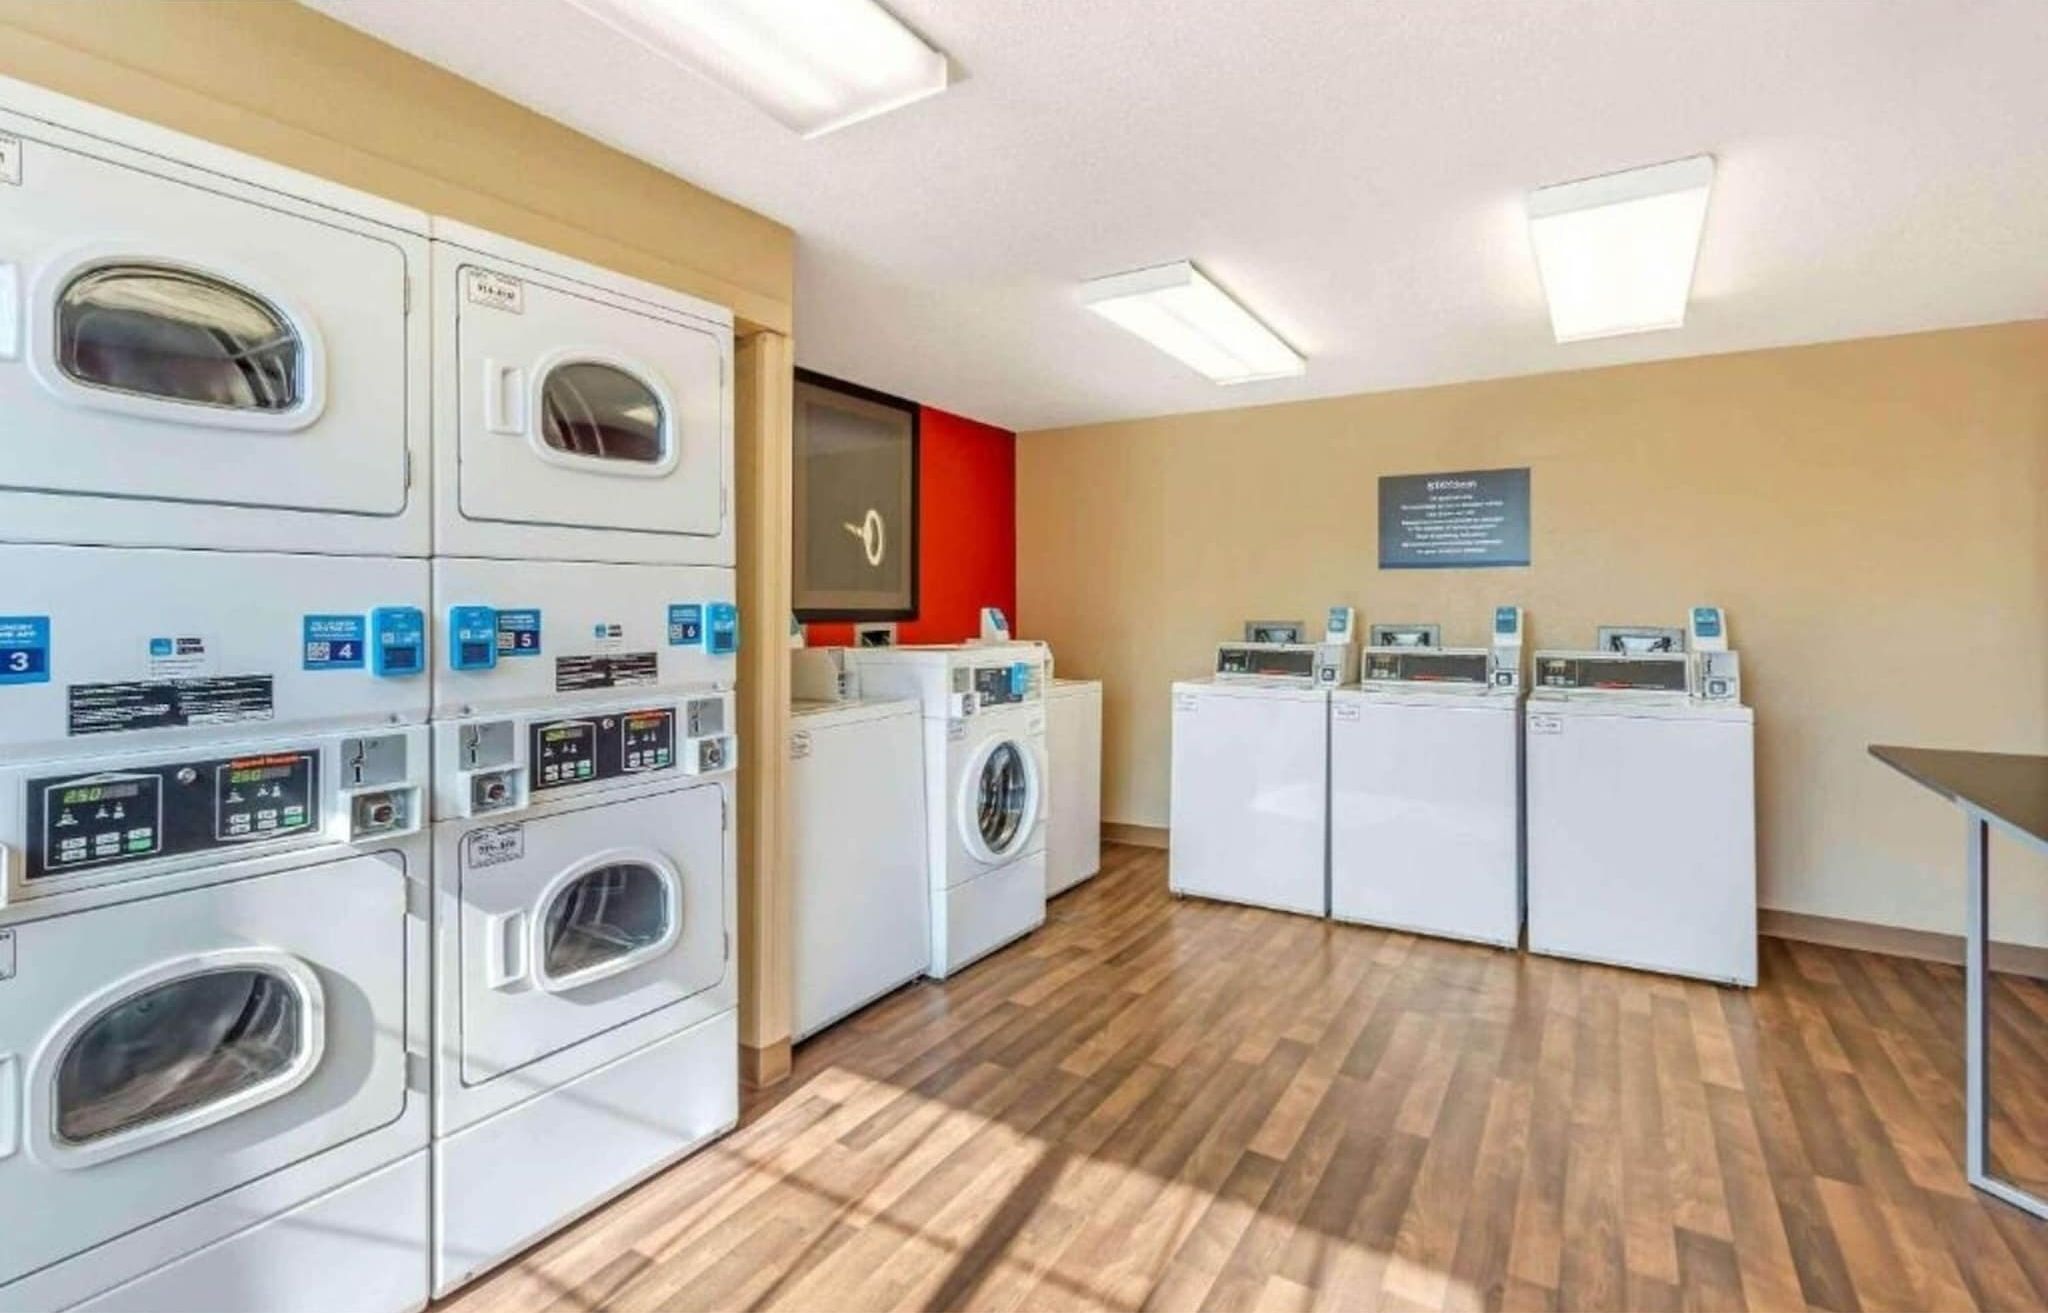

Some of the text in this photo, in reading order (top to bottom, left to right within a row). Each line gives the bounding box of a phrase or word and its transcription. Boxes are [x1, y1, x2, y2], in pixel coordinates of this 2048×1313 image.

[687, 625, 696, 637] 6
[521, 633, 531, 647] 5
[339, 643, 353, 658] 4
[9, 652, 29, 671] 3
